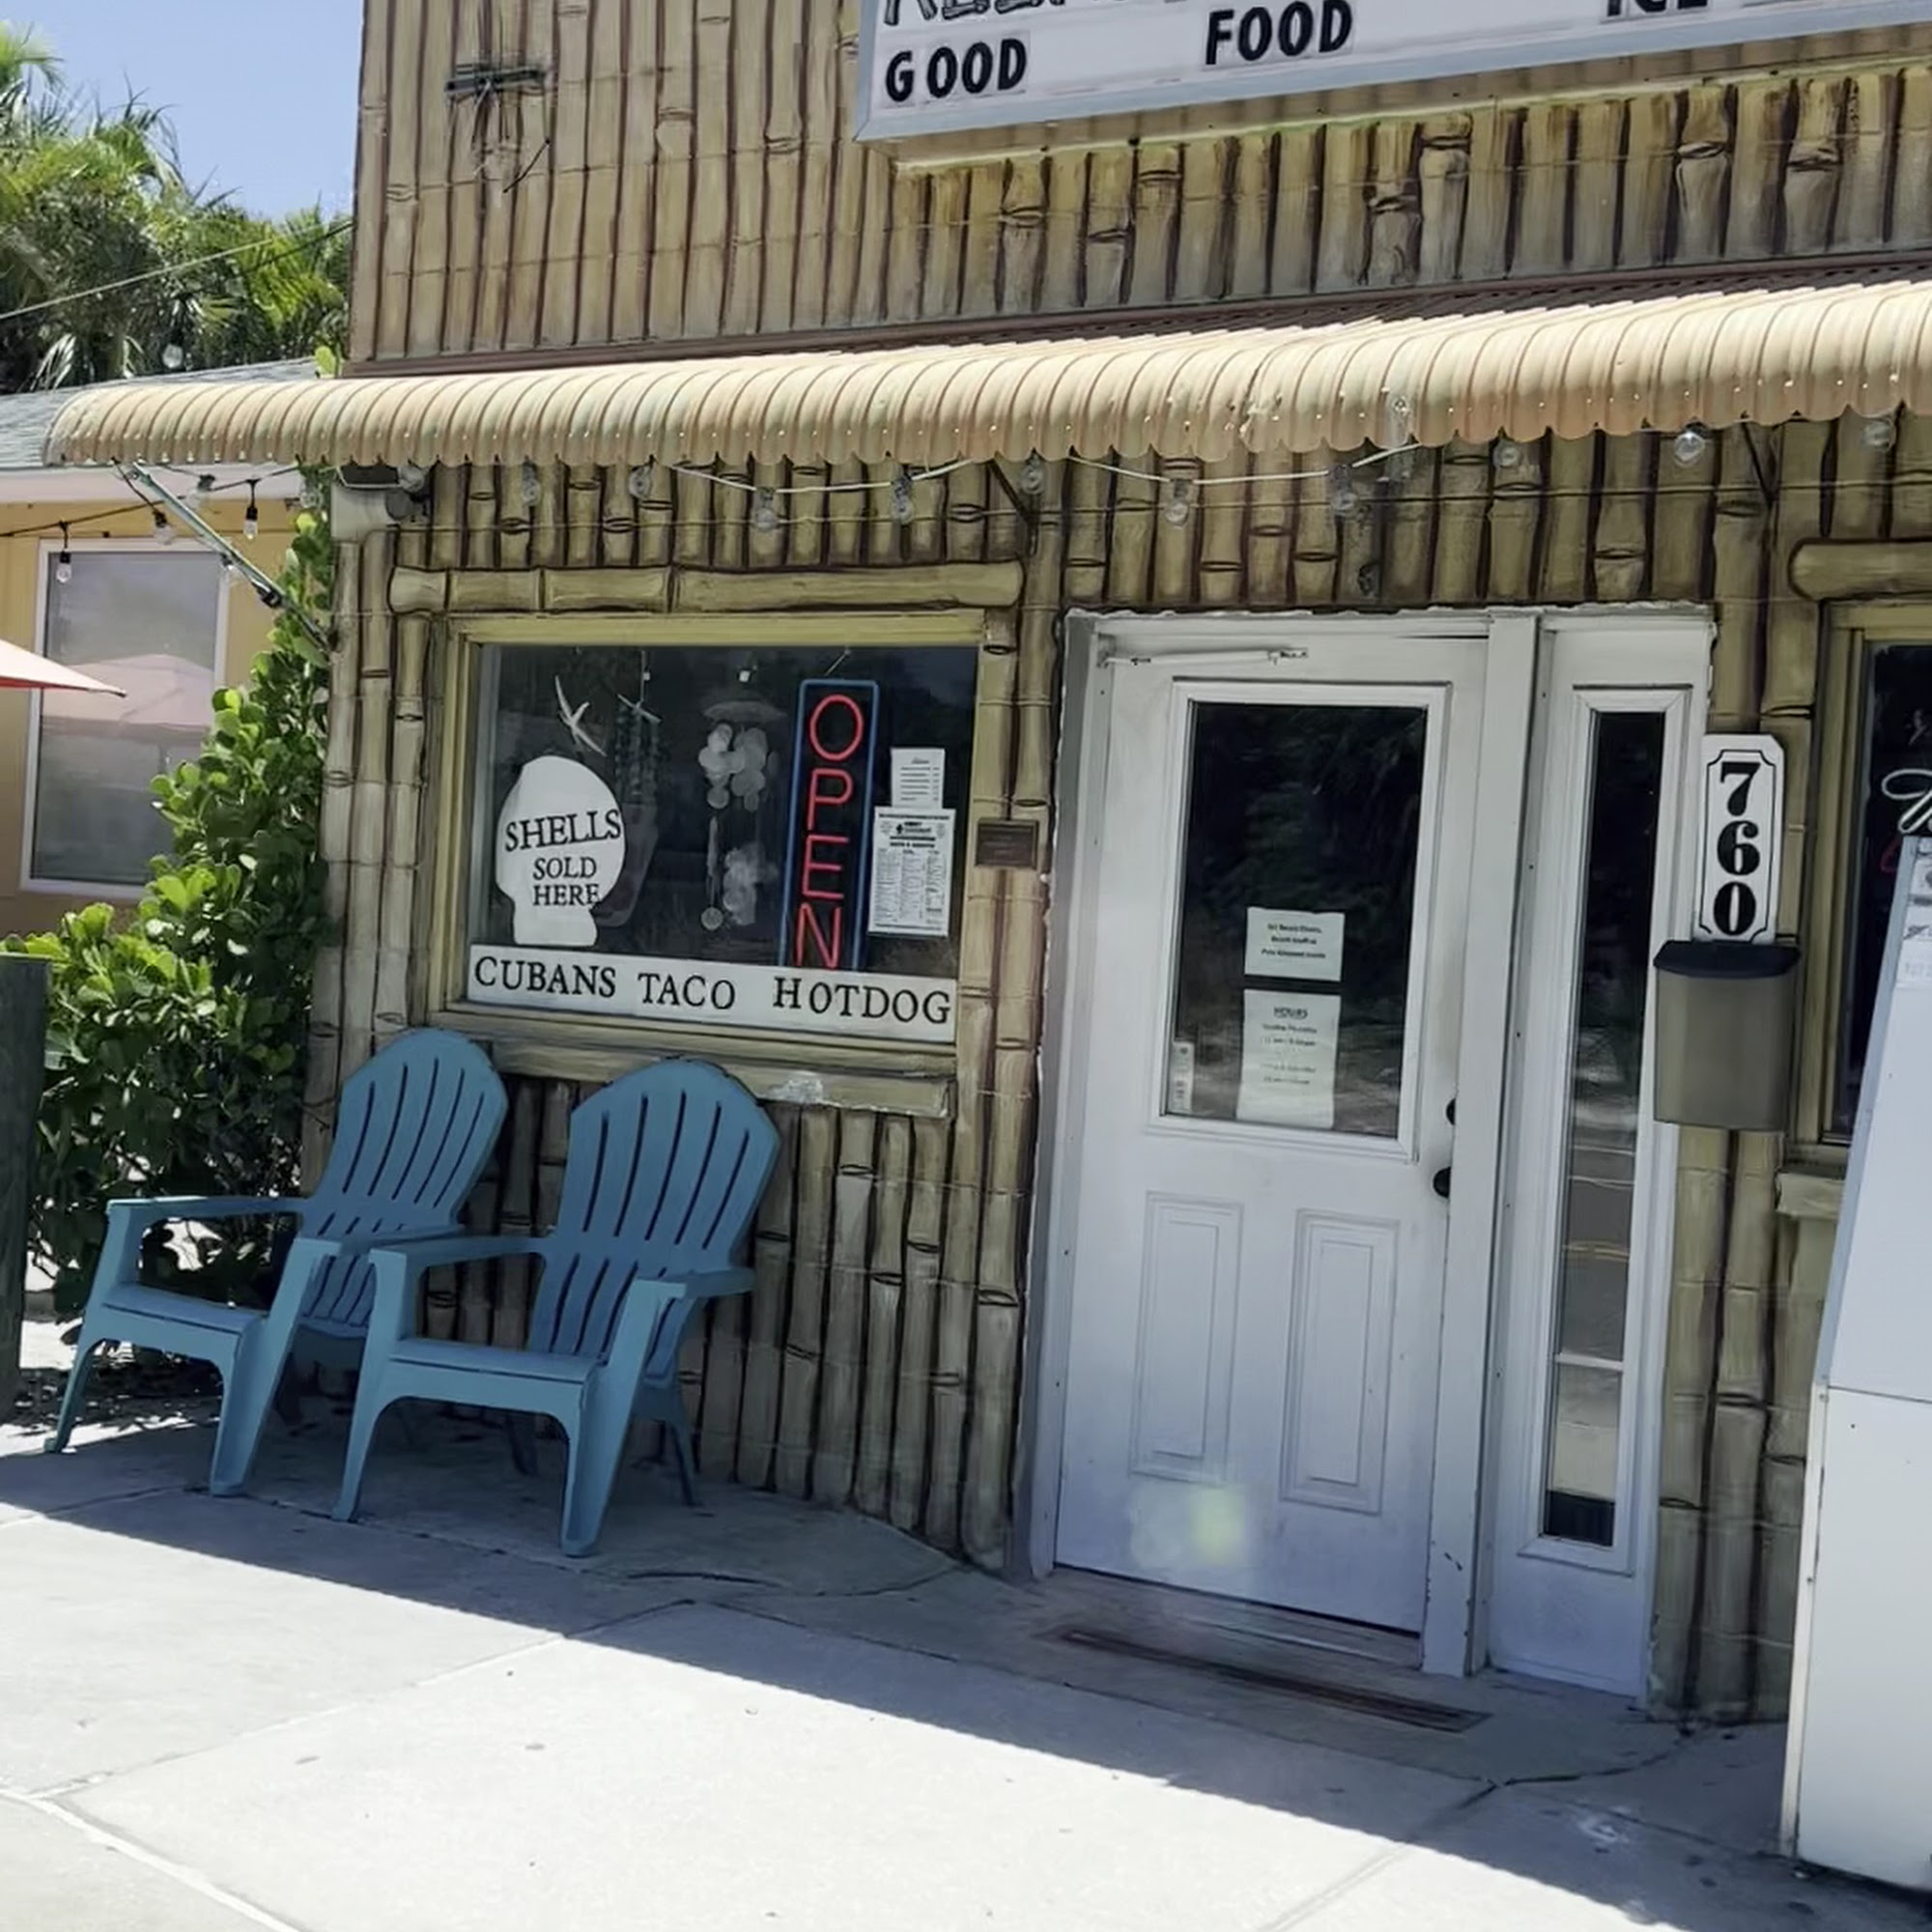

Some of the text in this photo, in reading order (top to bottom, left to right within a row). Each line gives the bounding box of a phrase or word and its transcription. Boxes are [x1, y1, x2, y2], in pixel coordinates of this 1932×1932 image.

[885, 0, 1353, 102] GOOD FOOD
[505, 809, 621, 852] SHELLS
[794, 694, 864, 969] OPEN
[1713, 761, 1761, 936] 760
[532, 856, 597, 880] SOLD
[532, 884, 601, 906] HERE
[474, 955, 951, 1024] CUBANS TACO HOTDOG
